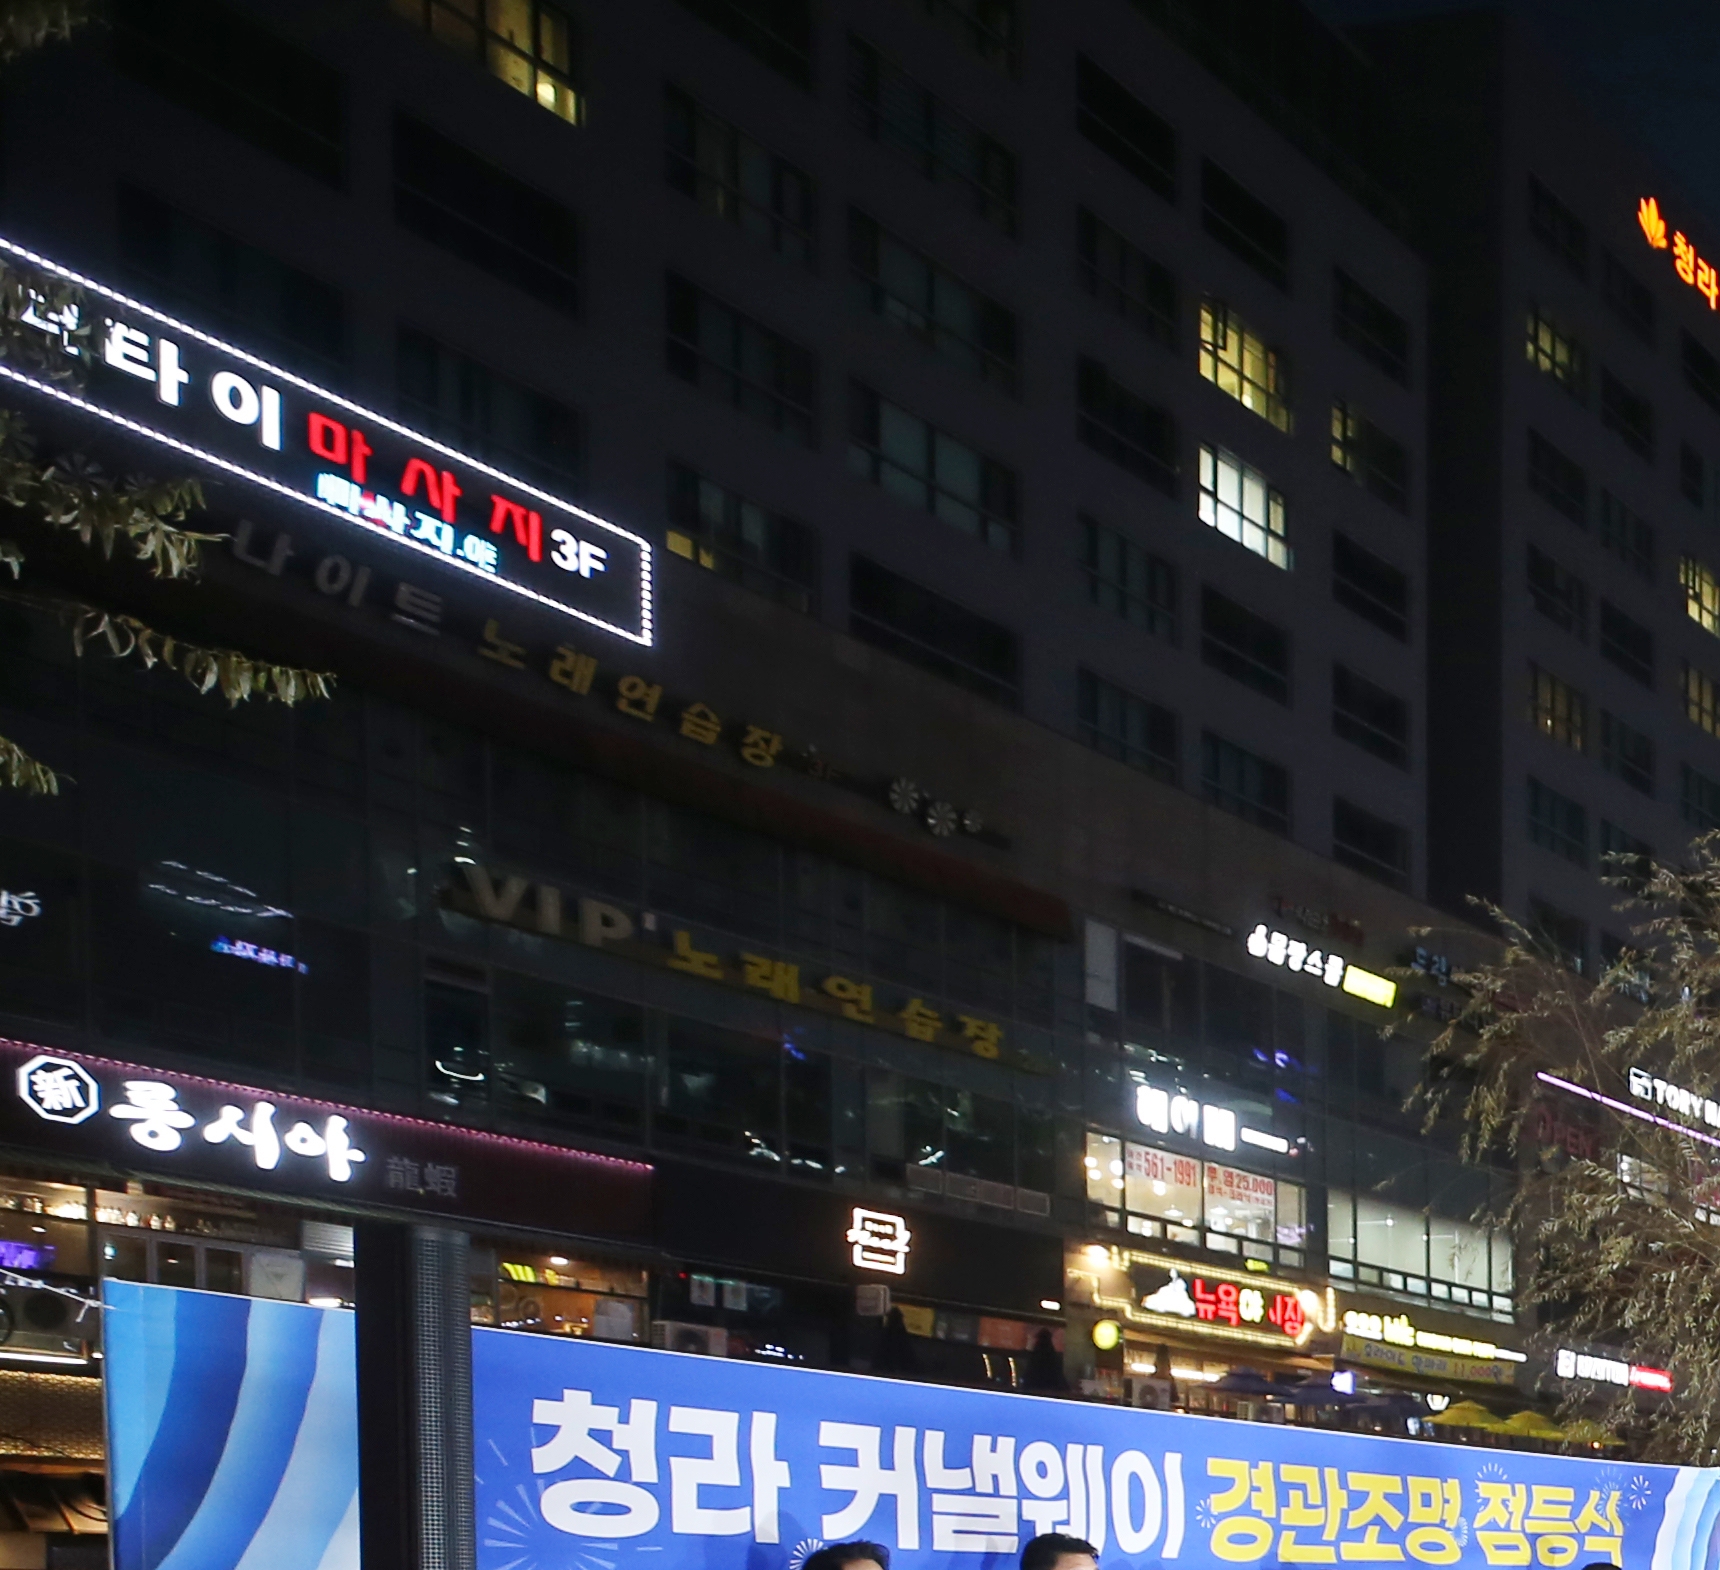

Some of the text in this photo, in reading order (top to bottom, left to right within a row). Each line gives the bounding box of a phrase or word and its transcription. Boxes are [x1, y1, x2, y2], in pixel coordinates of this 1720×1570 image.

[307, 410, 542, 563] 마사지
[549, 528, 608, 580] 3F
[231, 518, 445, 636] 나이트
[478, 616, 783, 769] 노래연습장
[458, 857, 1004, 1058] VIP 노래연습장
[530, 1388, 1626, 1570] 청라 커낼웨이 경관조명 점등식
